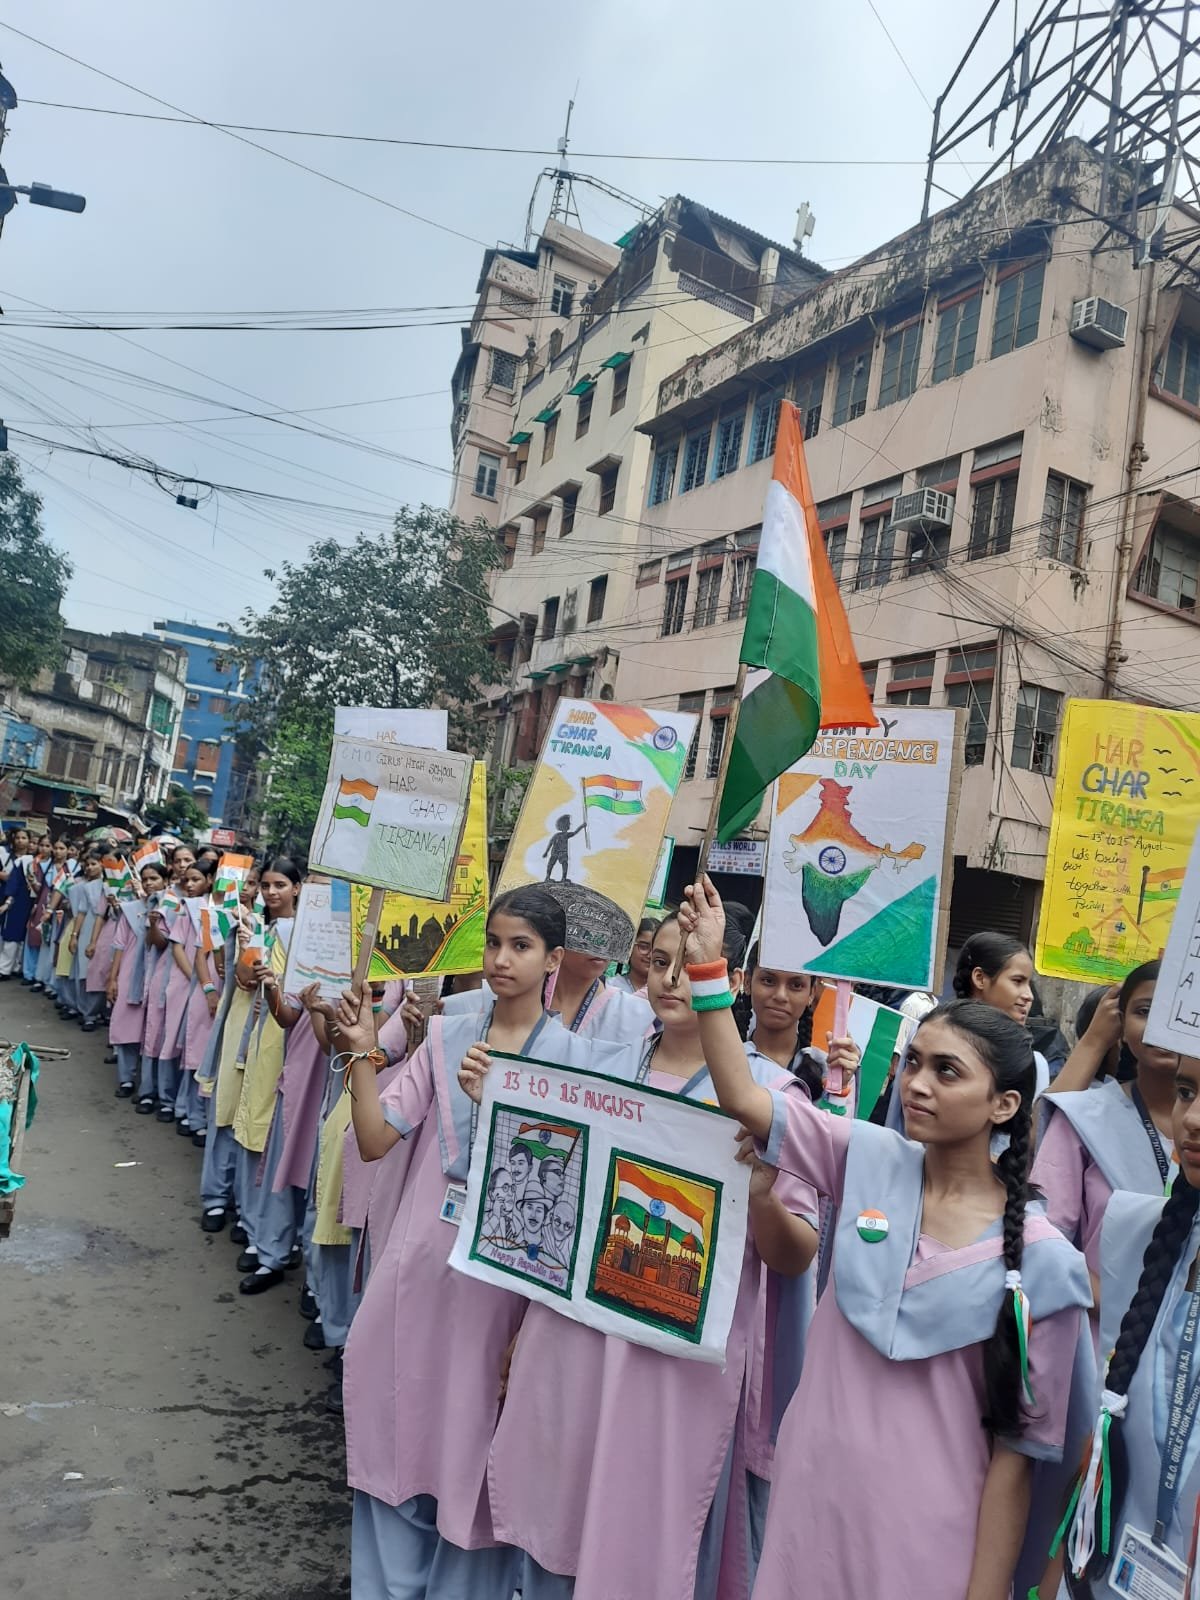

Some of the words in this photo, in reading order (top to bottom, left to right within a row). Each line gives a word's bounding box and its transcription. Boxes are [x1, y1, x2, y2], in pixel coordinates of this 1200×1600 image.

[567, 708, 597, 726] HAR
[376, 730, 398, 742] HAR
[557, 723, 598, 742] GHAR
[551, 739, 612, 761] TIRANGA
[1094, 733, 1145, 769] HAR
[428, 763, 457, 779] SCHOOL
[833, 760, 878, 779] DAY
[389, 773, 418, 793] HAR
[1081, 763, 1151, 800] GHAR
[408, 800, 448, 821] GHAR
[1076, 796, 1165, 836] TIRANGA
[733, 842, 757, 852] WORLD
[583, 1089, 646, 1123] AUGUST
[1174, 1373, 1188, 1407] SCHOOL
[1170, 1406, 1183, 1428] HIGH
[1179, 1414, 1192, 1438] HIGH
[1171, 1434, 1186, 1464] GIRLS'
[1164, 1464, 1179, 1490] C.M.O.
